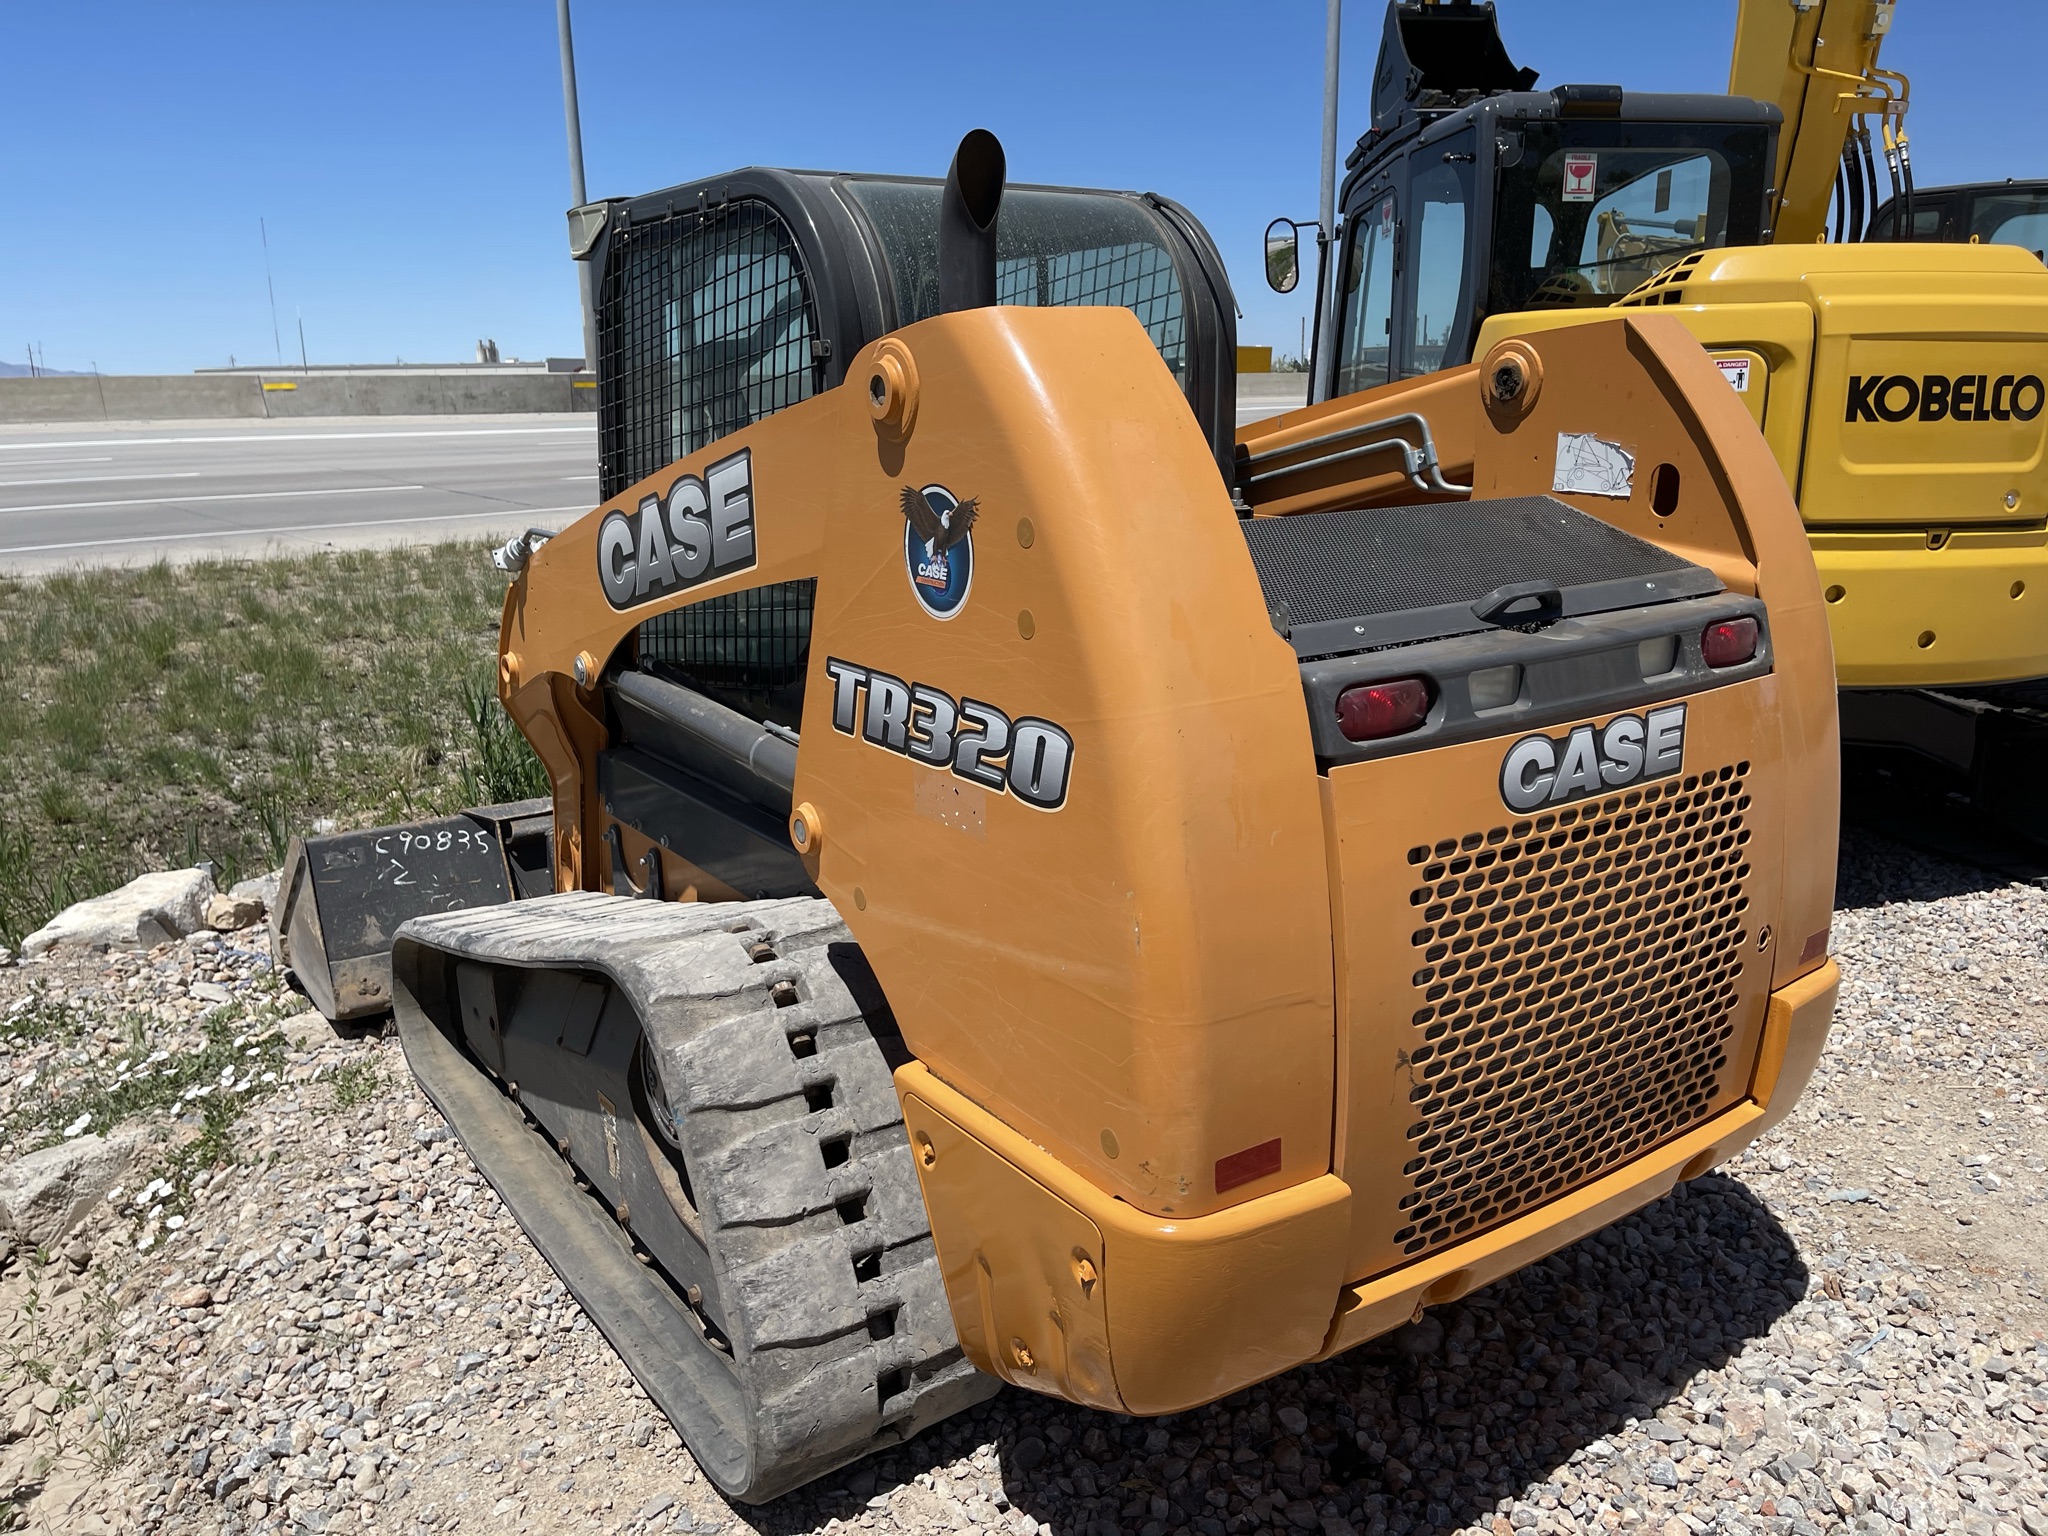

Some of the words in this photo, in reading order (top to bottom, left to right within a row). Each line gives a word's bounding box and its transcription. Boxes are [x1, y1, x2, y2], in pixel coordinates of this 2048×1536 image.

[1845, 374, 2045, 423] KOBELCO
[598, 450, 756, 608] CASE
[917, 563, 948, 580] CASE
[827, 657, 1074, 811] TR320
[1501, 704, 1686, 812] CASE
[375, 830, 489, 855] C90835
